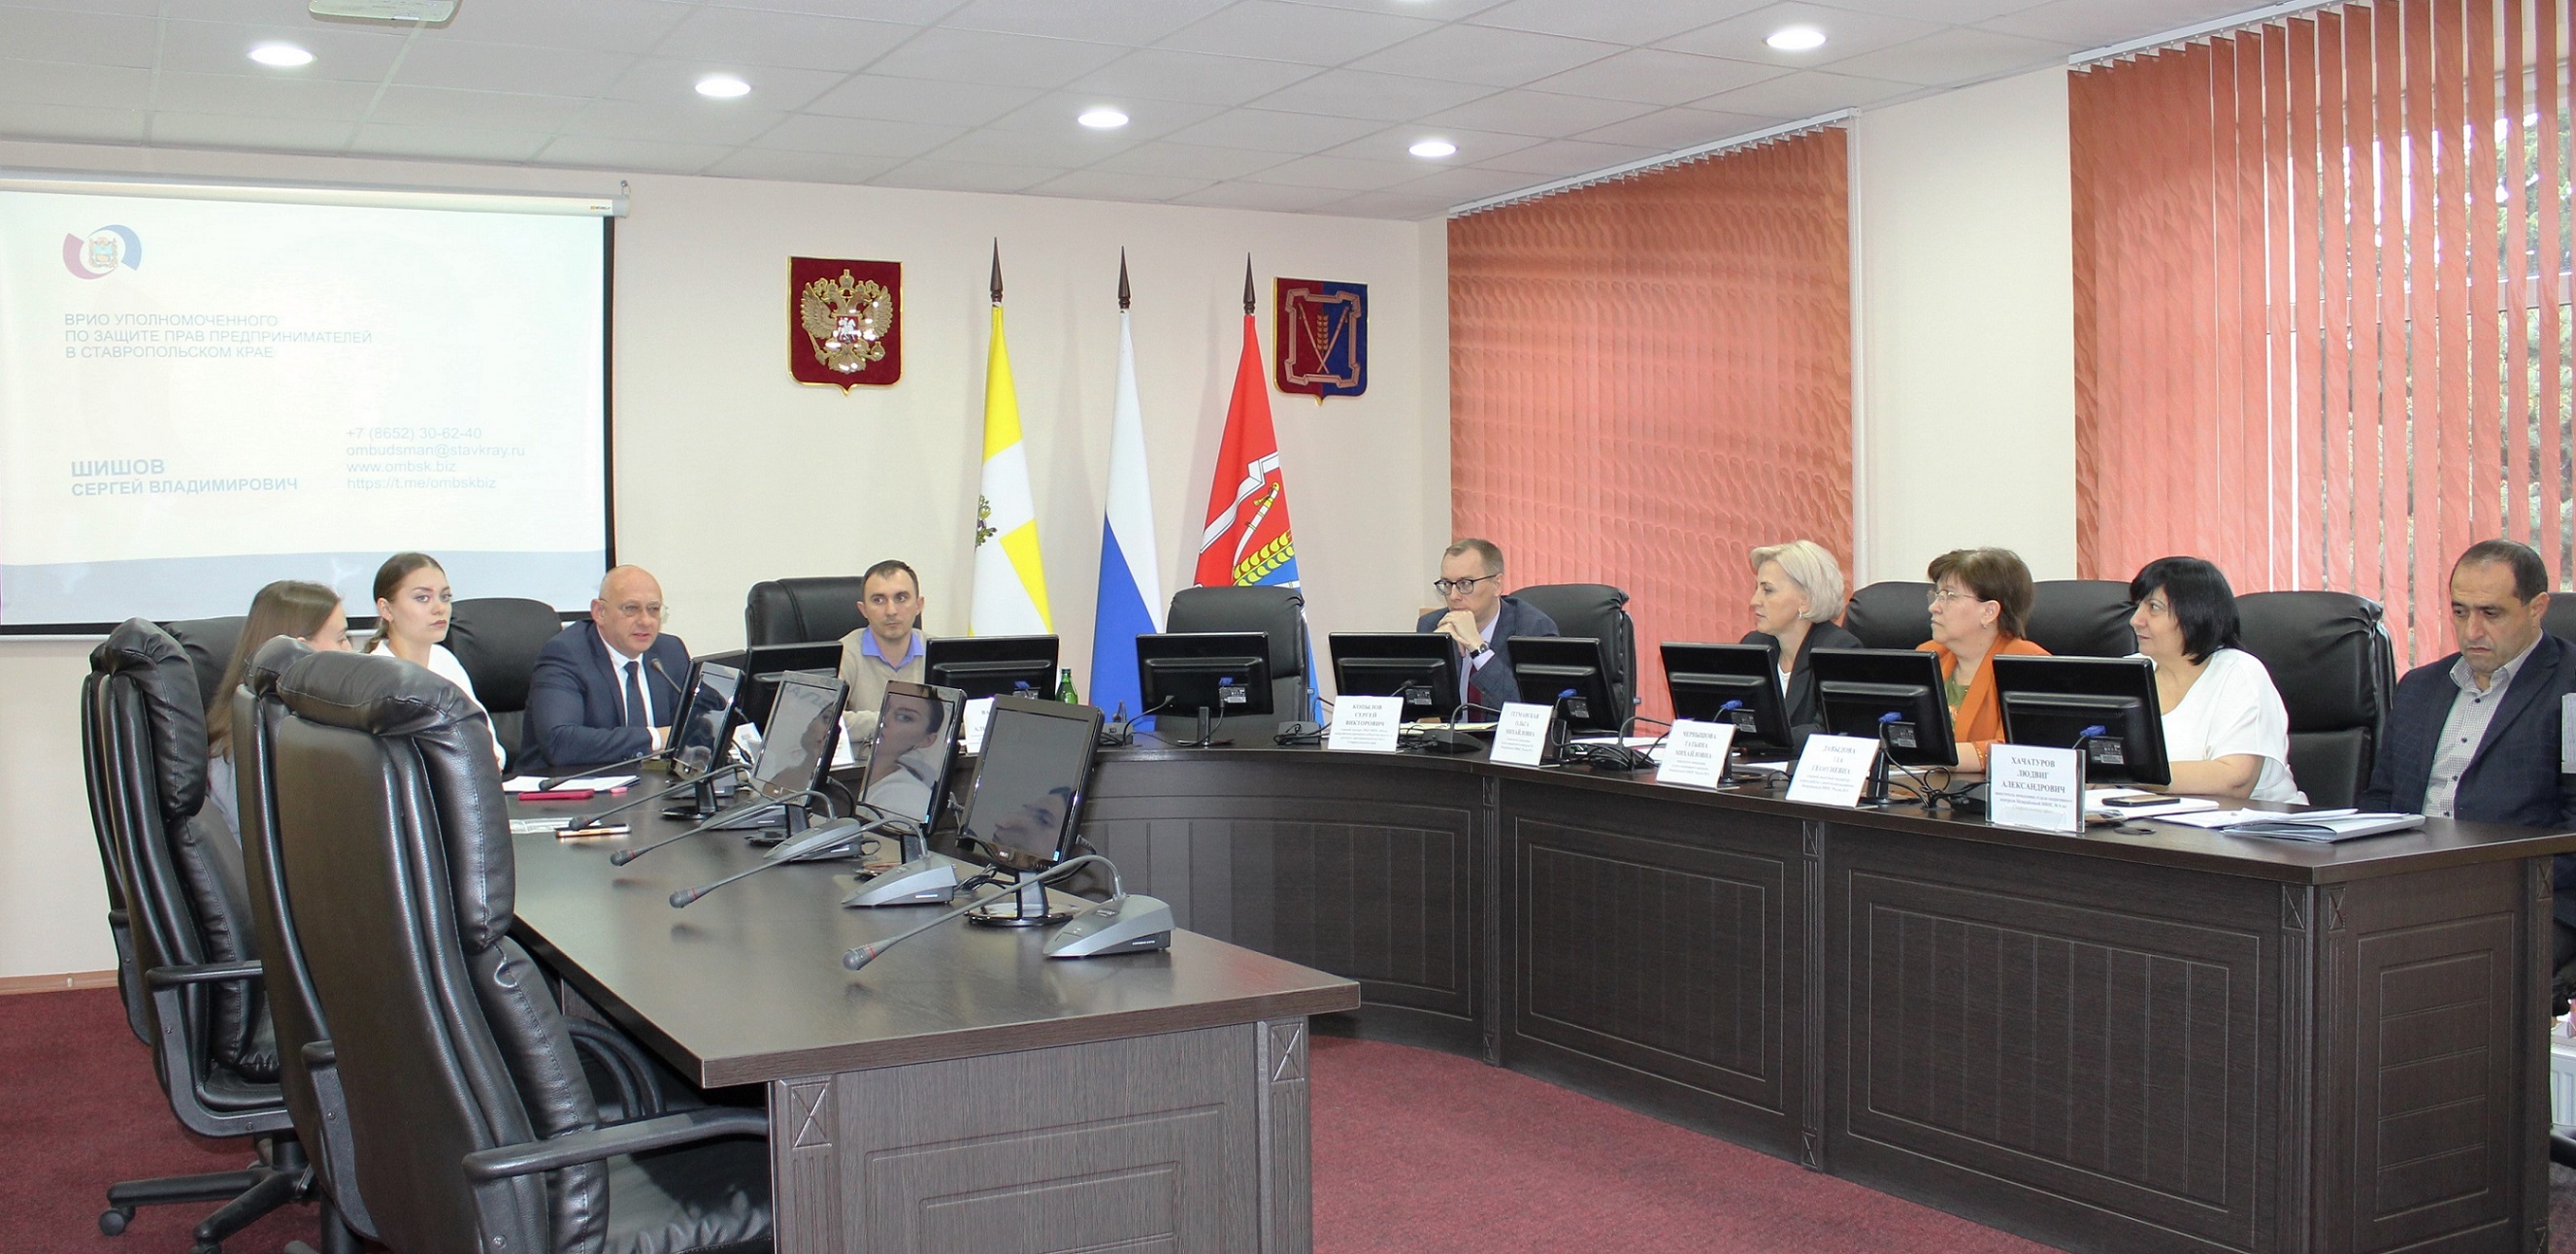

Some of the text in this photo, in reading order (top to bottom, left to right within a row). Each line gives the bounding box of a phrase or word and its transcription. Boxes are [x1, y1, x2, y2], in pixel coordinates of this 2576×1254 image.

[65, 314, 278, 326] ВРИО УПОЛНОМОЧЕННОГО
[65, 329, 373, 346] ПО ЗАЩИТЕ ПРАВ ПРЕДПРИНИМАТЕЛЕЙ
[66, 346, 274, 358] В СТАВРОПОЛЬСКОМ КРАЕ
[347, 427, 481, 442] +7 (8652) 30-62-40
[347, 444, 525, 458] ombudsman@stavkray.ru
[71, 459, 165, 478] ШИШОВ
[347, 461, 456, 473] www.ombsk.biz
[72, 478, 297, 496] СЕРГЕЙ ВЛАДИМИРОВИЧ
[347, 477, 496, 490] https://t.me/ombskbiz
[2011, 757, 2056, 768] ХАЧАТУРОВ
[2017, 770, 2048, 779] ЛЮДВИГ
[2001, 781, 2065, 793] АЛЕКСАНДРОВИЧ
